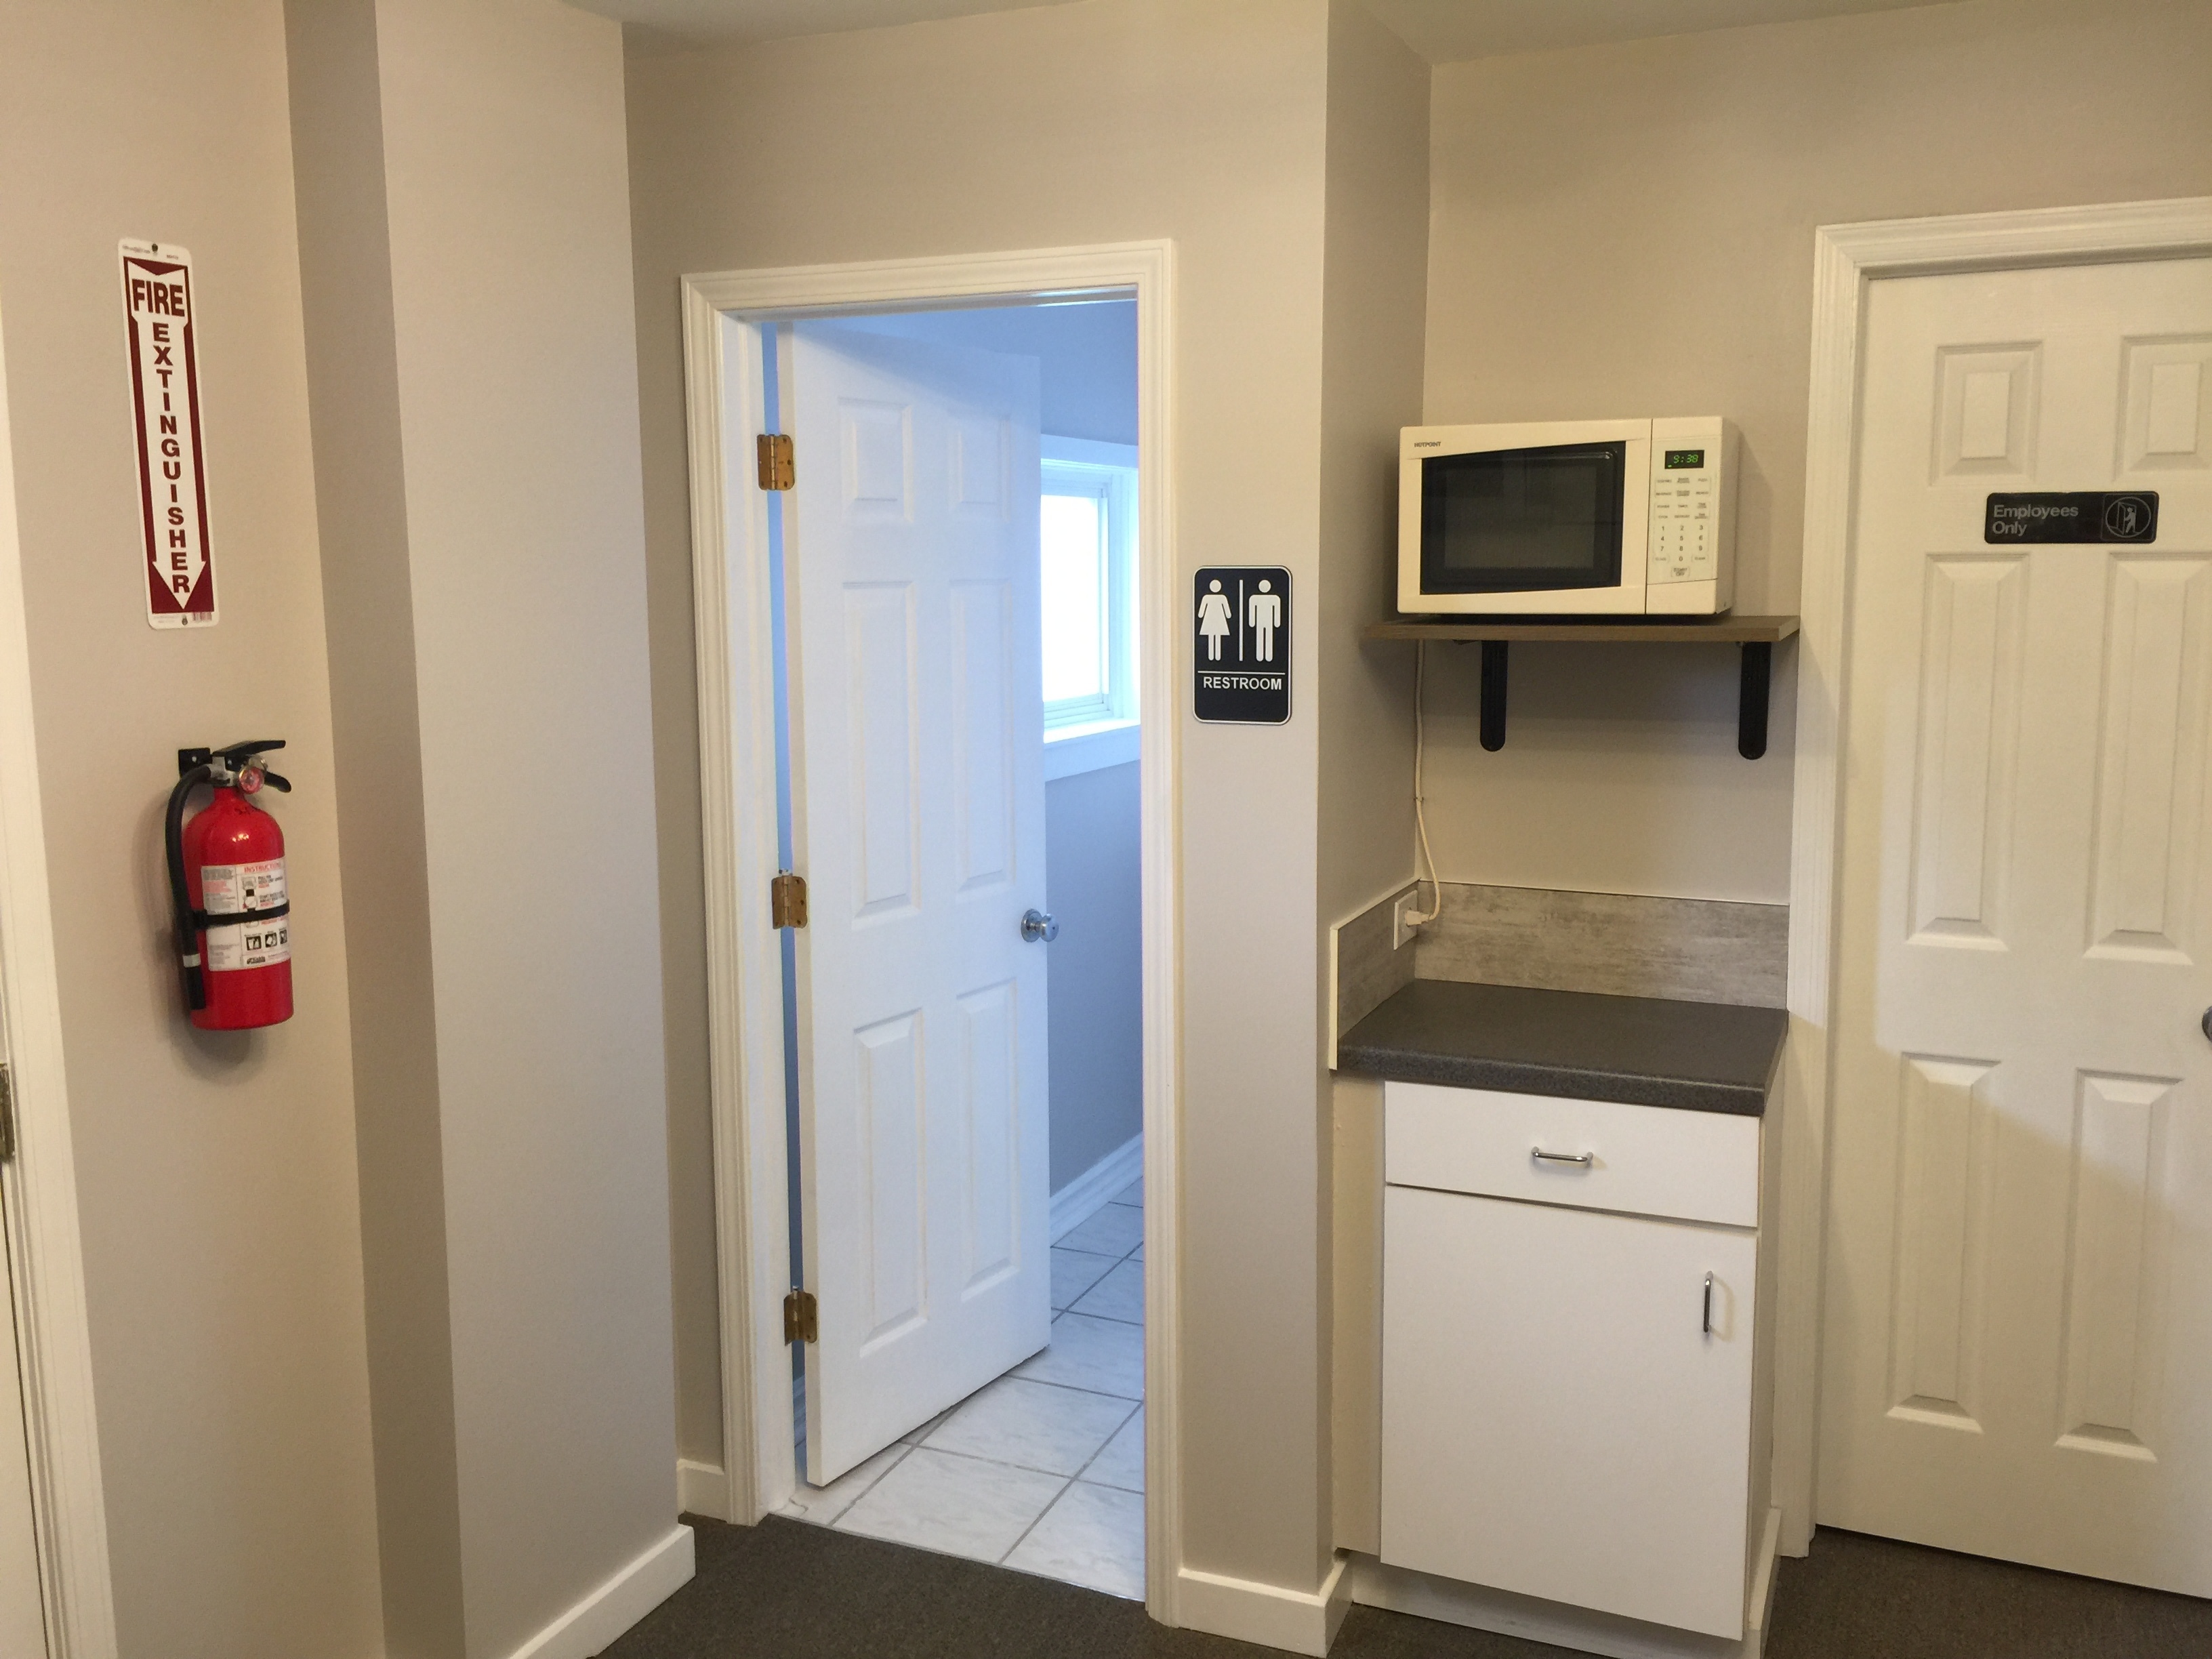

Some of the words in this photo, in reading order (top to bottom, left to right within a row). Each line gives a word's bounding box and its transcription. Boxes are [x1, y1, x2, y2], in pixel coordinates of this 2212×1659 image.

[131, 278, 185, 317] FIRE
[152, 321, 190, 593] EXTINGUISHER
[1994, 504, 2079, 520] Employees
[1992, 520, 2028, 537] Only
[1203, 676, 1282, 691] RESTROOM
